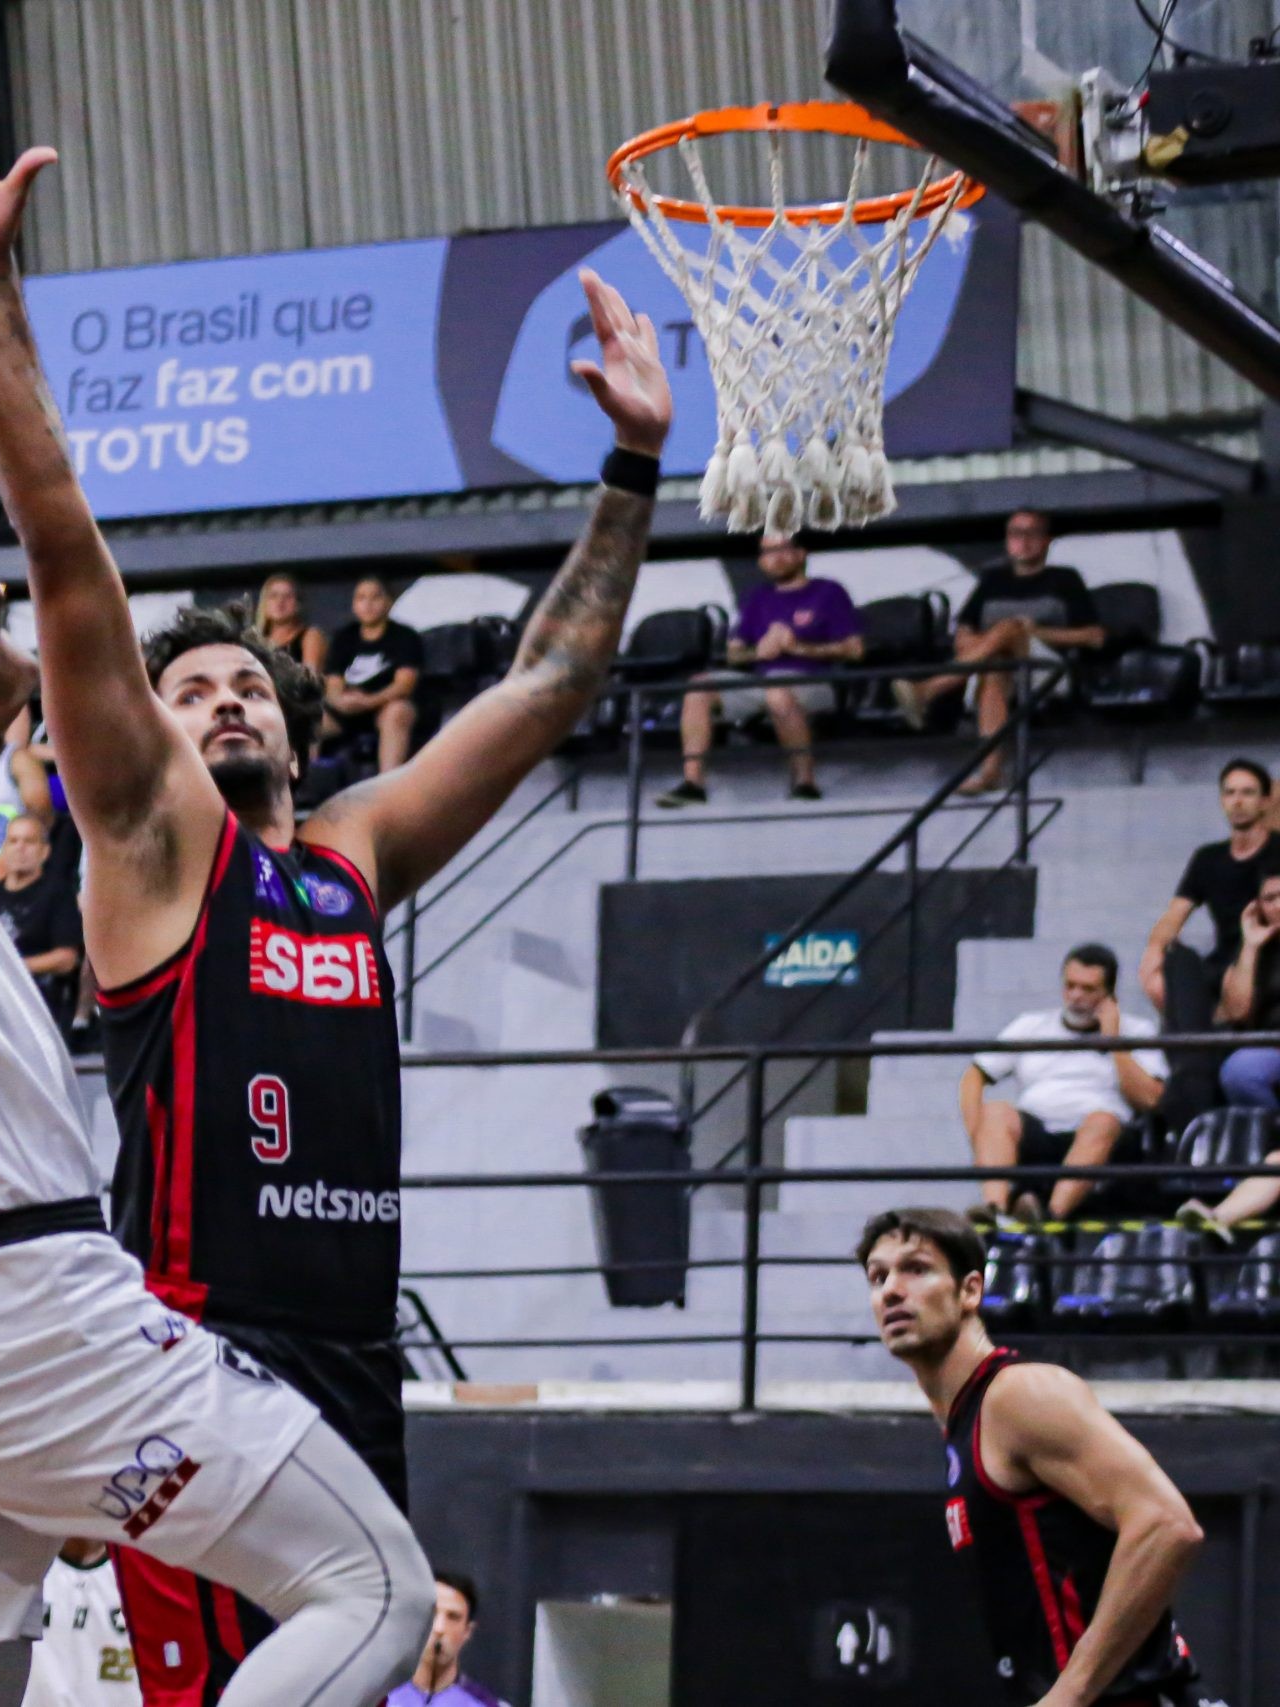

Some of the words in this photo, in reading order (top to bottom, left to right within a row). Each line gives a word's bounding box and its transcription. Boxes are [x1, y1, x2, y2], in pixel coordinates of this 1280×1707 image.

[71, 309, 109, 355] O
[123, 293, 261, 350] Brasil
[272, 293, 373, 347] que
[67, 367, 143, 415] faz
[156, 358, 240, 409] faz
[249, 354, 373, 400] com
[766, 932, 856, 968] AÍDA
[248, 1073, 291, 1165] 9
